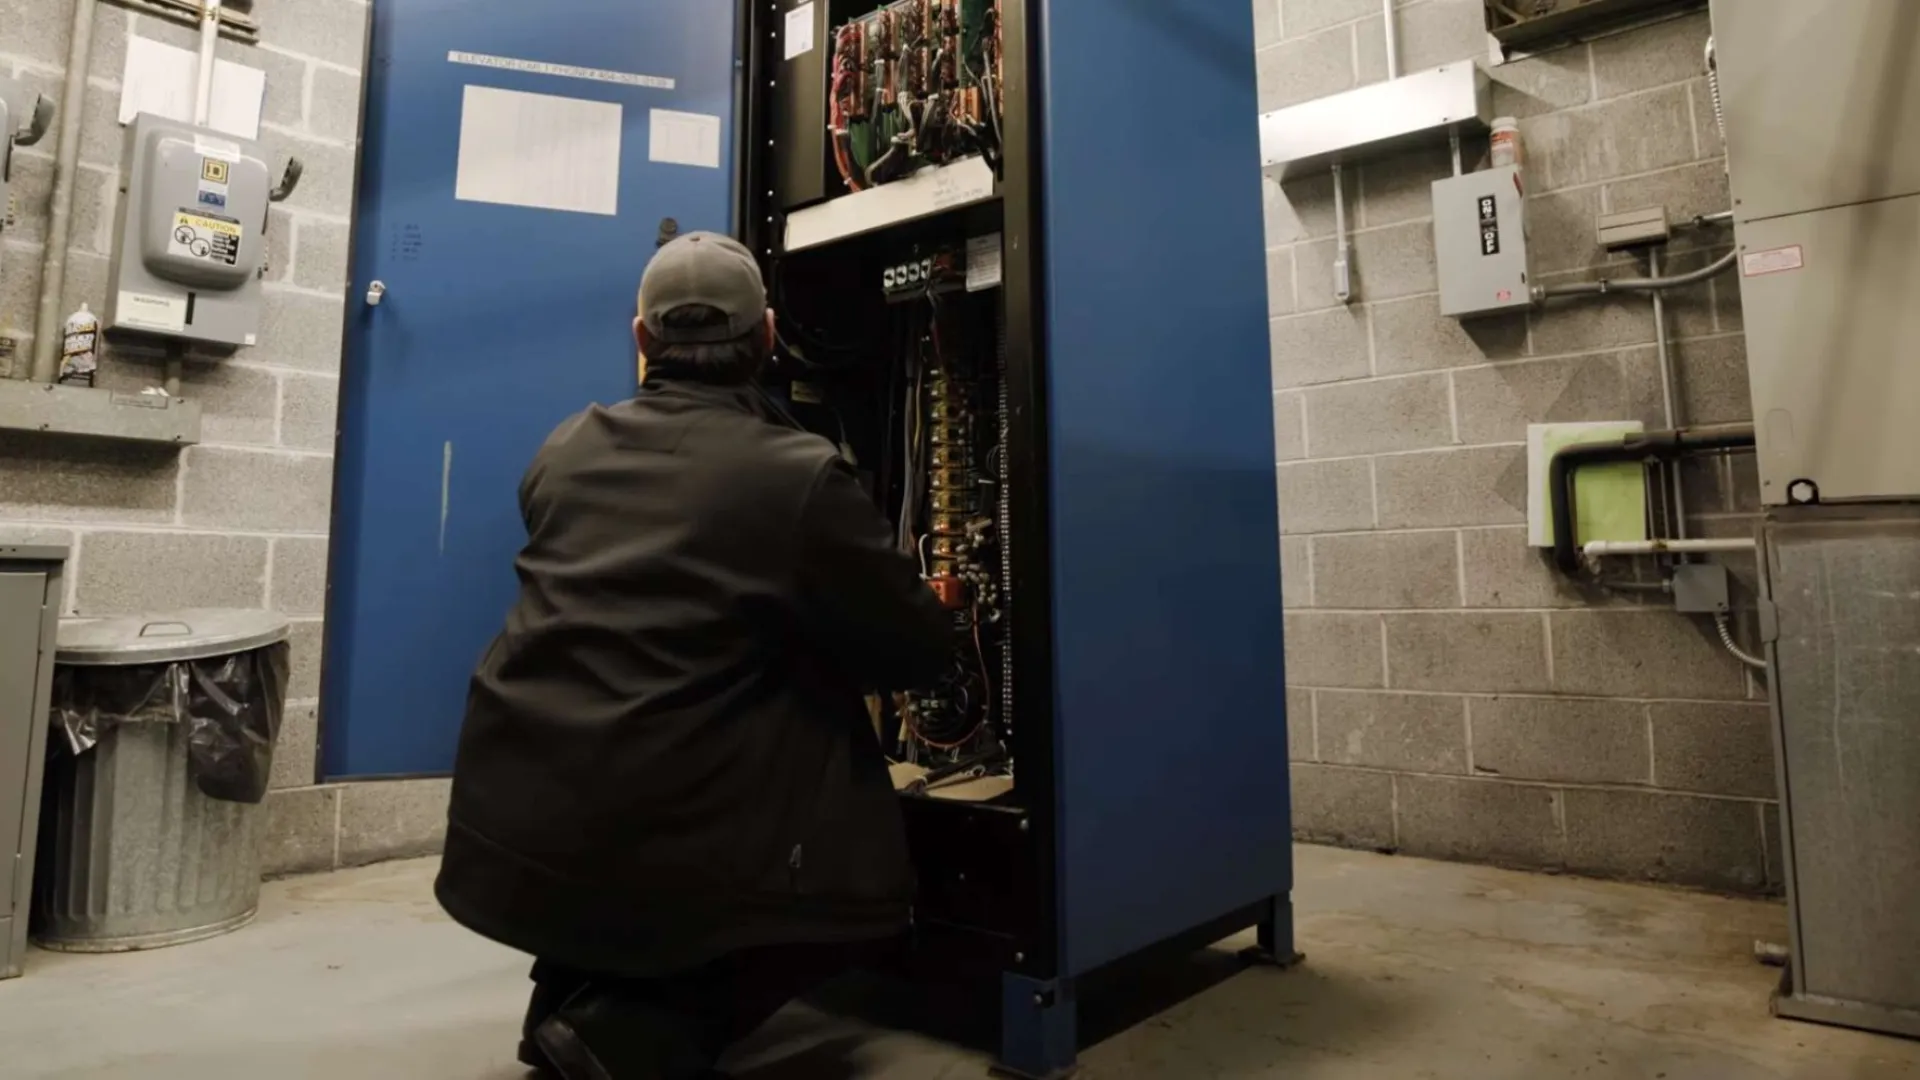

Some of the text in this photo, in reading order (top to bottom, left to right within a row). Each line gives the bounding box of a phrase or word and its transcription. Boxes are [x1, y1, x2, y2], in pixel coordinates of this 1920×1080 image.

[457, 53, 514, 68] ELEVATOR
[1482, 199, 1493, 214] ON
[195, 218, 237, 233] CAUTION
[1484, 231, 1495, 253] OFF
